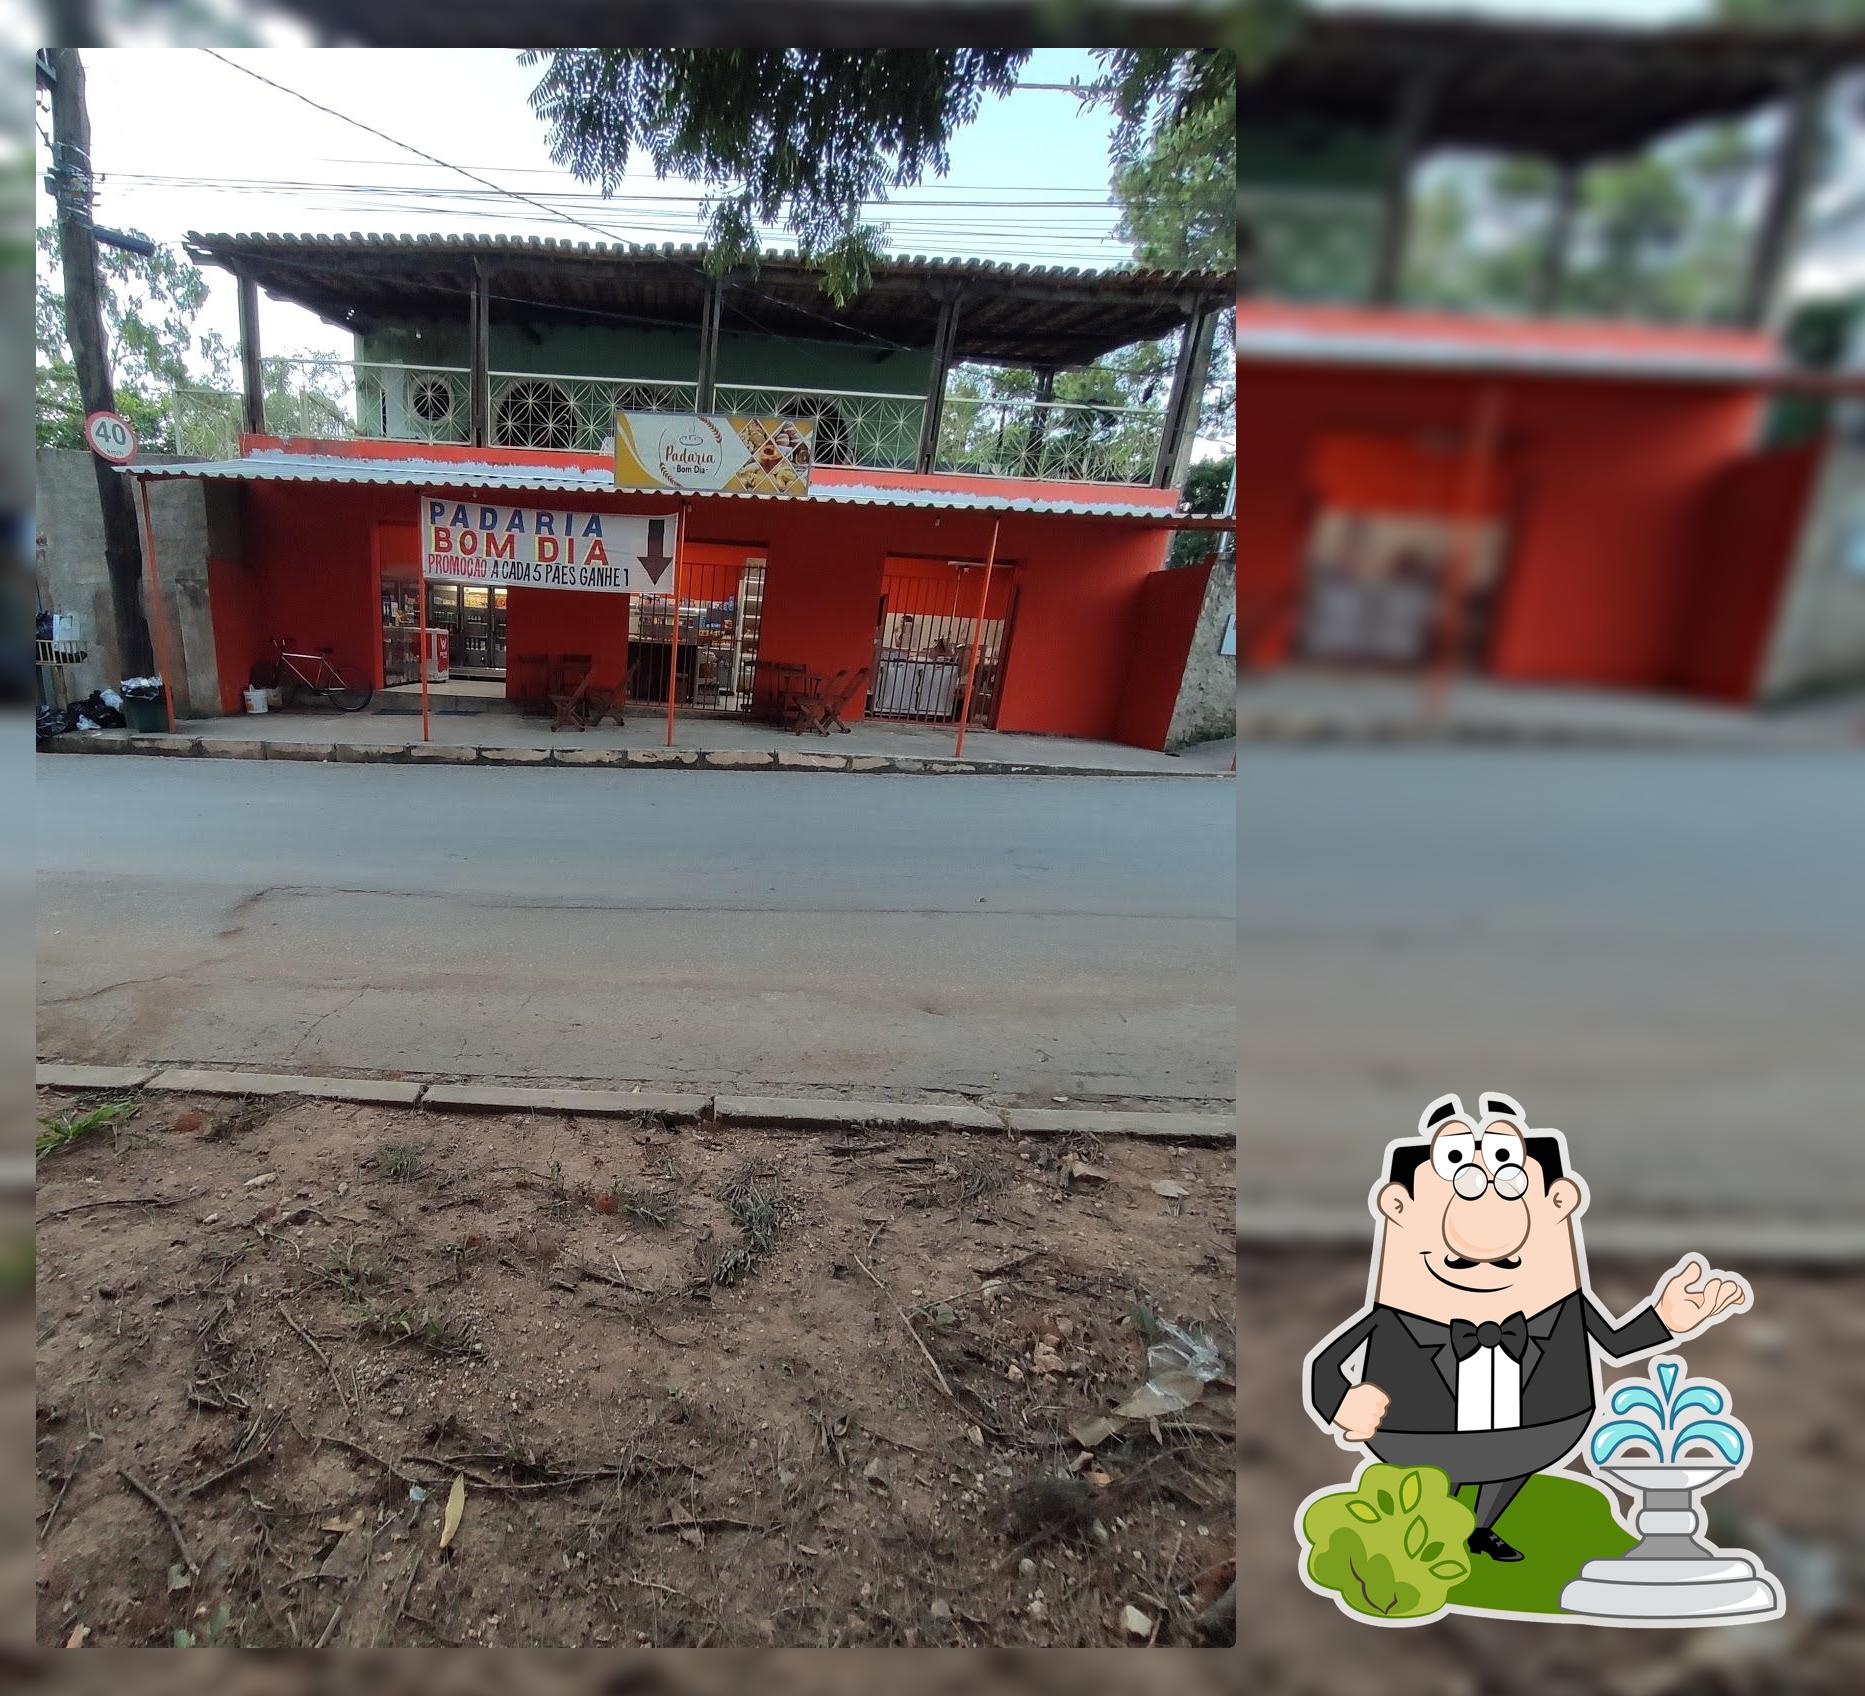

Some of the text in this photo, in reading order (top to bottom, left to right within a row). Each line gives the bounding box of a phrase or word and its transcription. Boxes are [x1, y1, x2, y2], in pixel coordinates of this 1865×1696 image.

[95, 421, 126, 445] 40
[665, 445, 715, 465] Padaria
[429, 501, 603, 538] PADARIA
[432, 526, 609, 566] BOM DIA
[428, 553, 629, 587] PROMOÇÃO A CADA 5 PÃES GANHE 1
